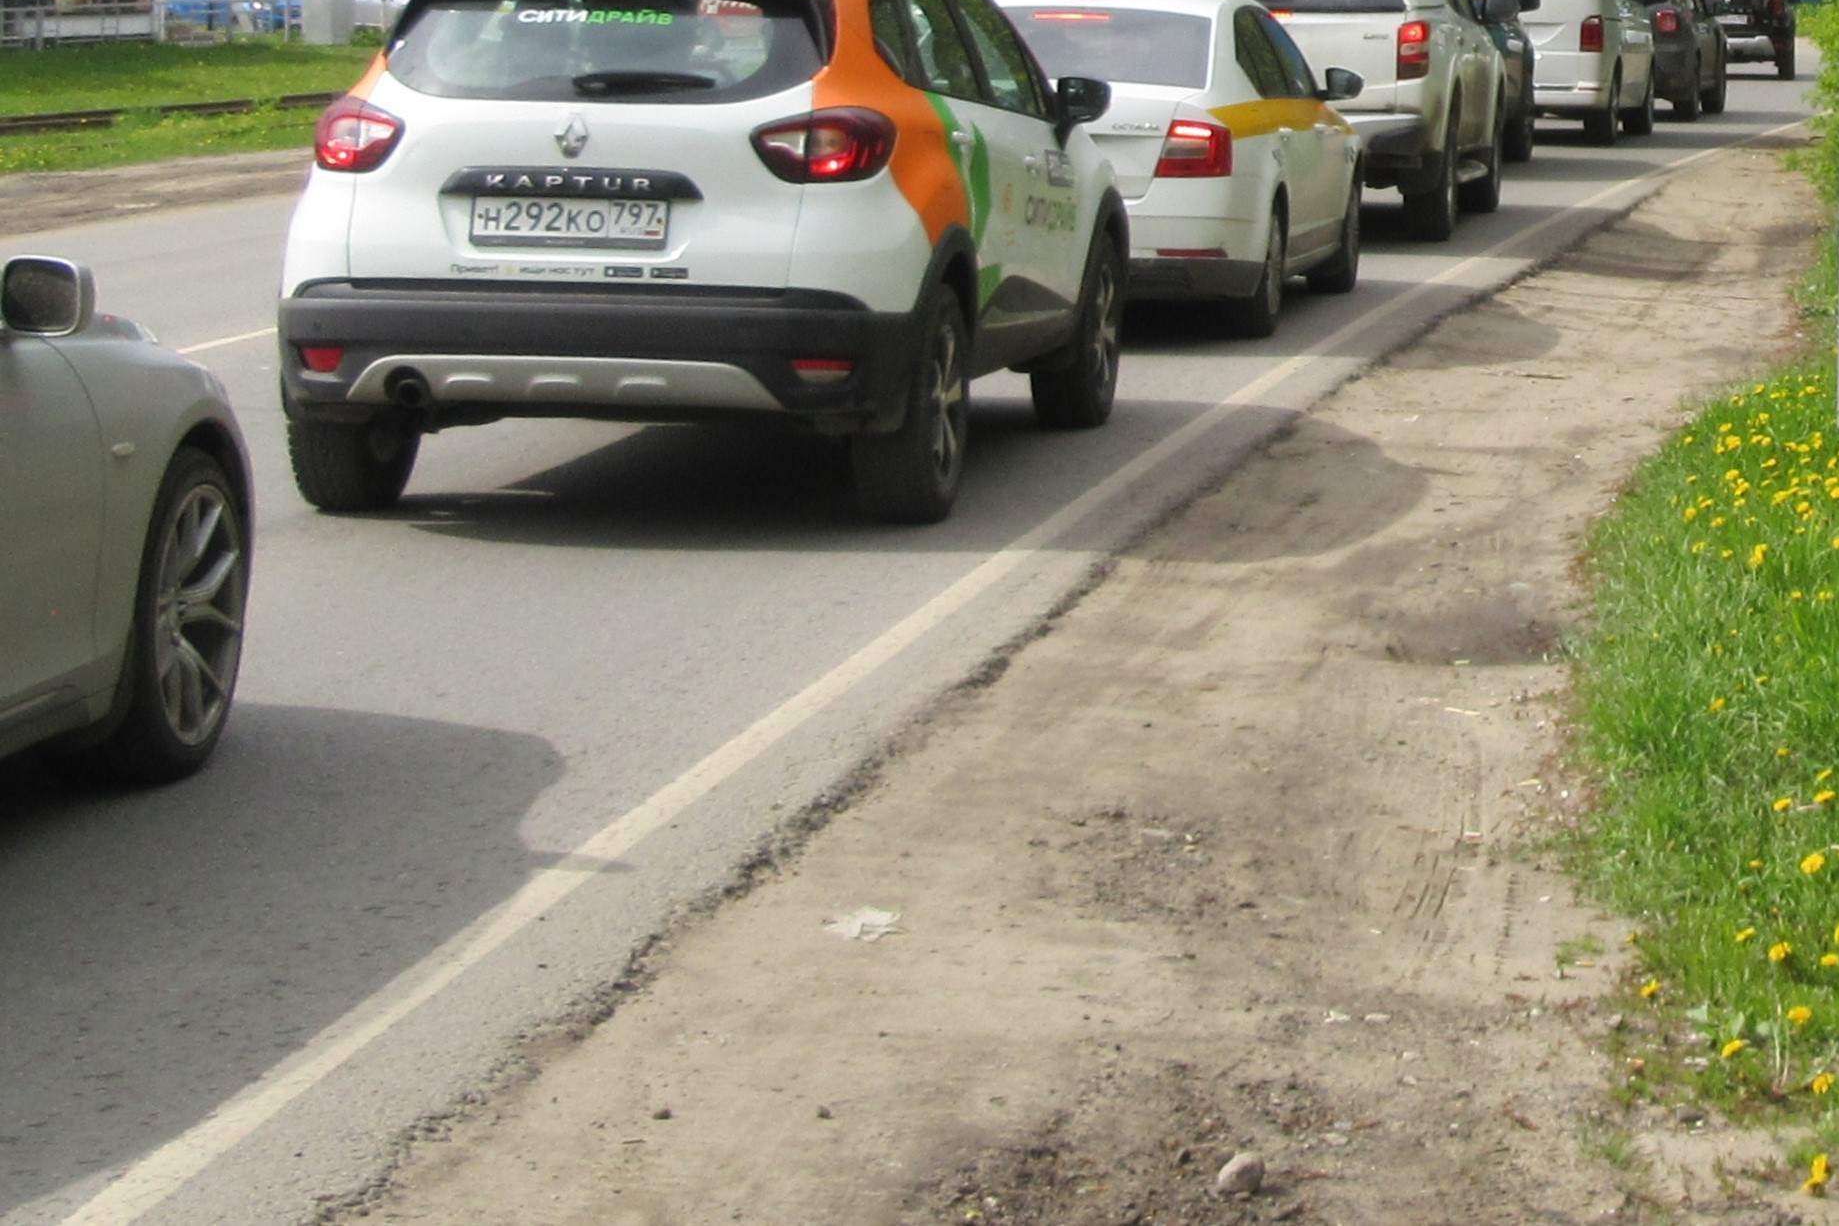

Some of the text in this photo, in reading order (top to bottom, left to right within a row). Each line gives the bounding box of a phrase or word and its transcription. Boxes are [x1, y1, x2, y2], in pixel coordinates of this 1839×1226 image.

[518, 9, 673, 24] СИТИДРАЙВ
[486, 175, 651, 190] KAPTUR
[613, 202, 659, 225] 797
